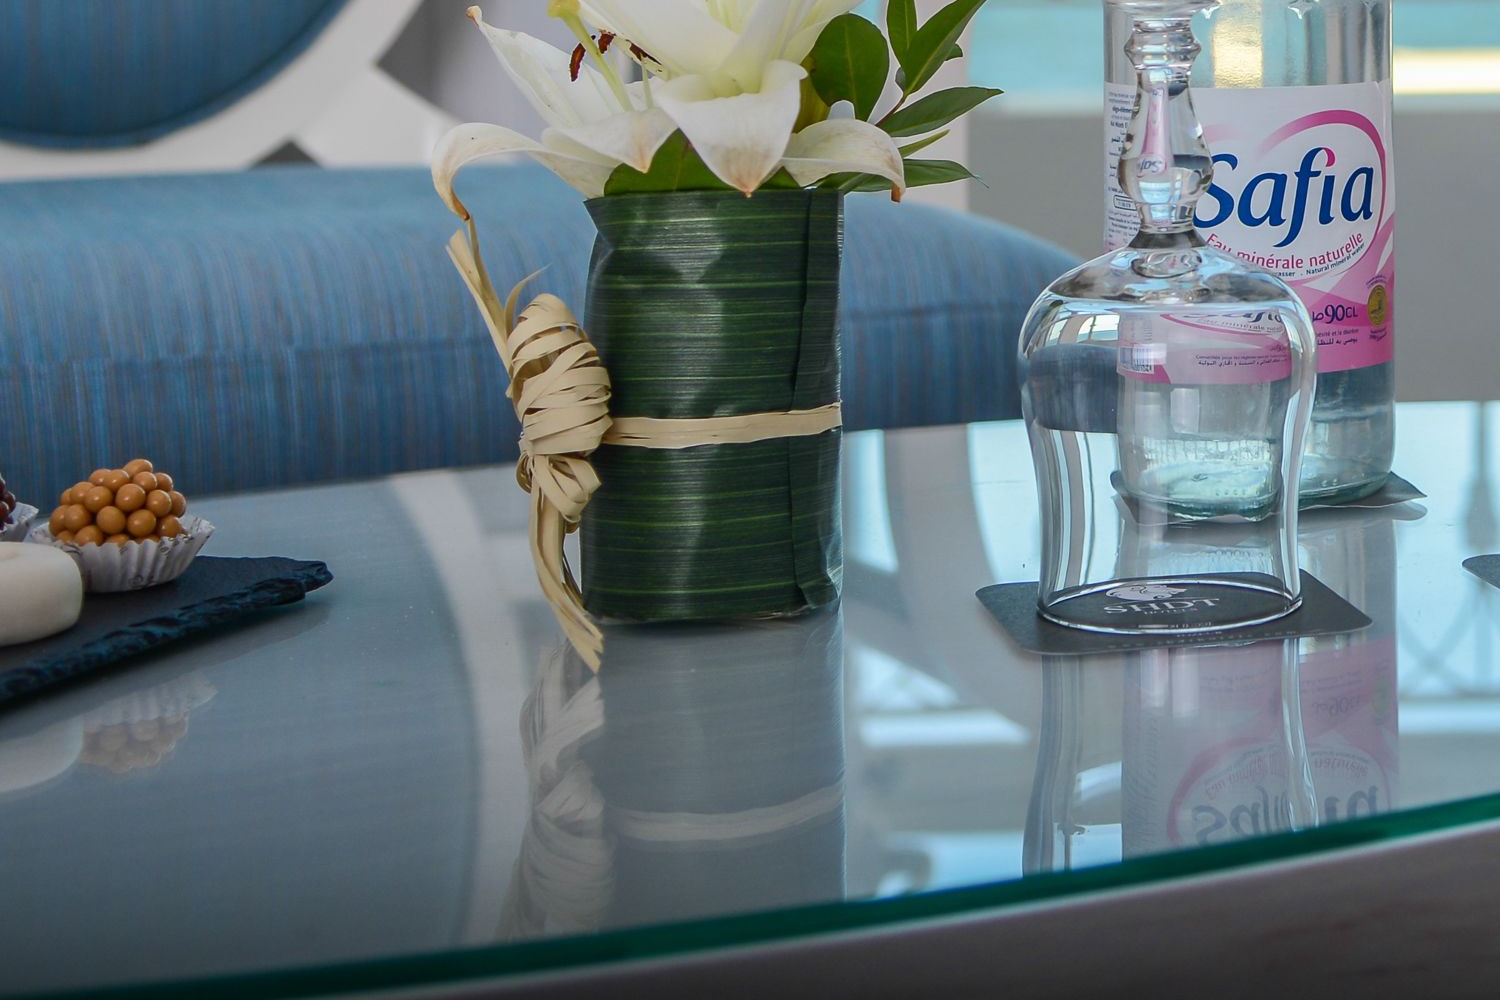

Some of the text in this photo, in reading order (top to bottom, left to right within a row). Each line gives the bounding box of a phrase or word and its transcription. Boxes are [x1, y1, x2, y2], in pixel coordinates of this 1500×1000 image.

[1193, 147, 1375, 248] Safia
[1237, 251, 1303, 270] minérale
[1309, 232, 1363, 267] naturelle
[1306, 264, 1330, 275] Natural
